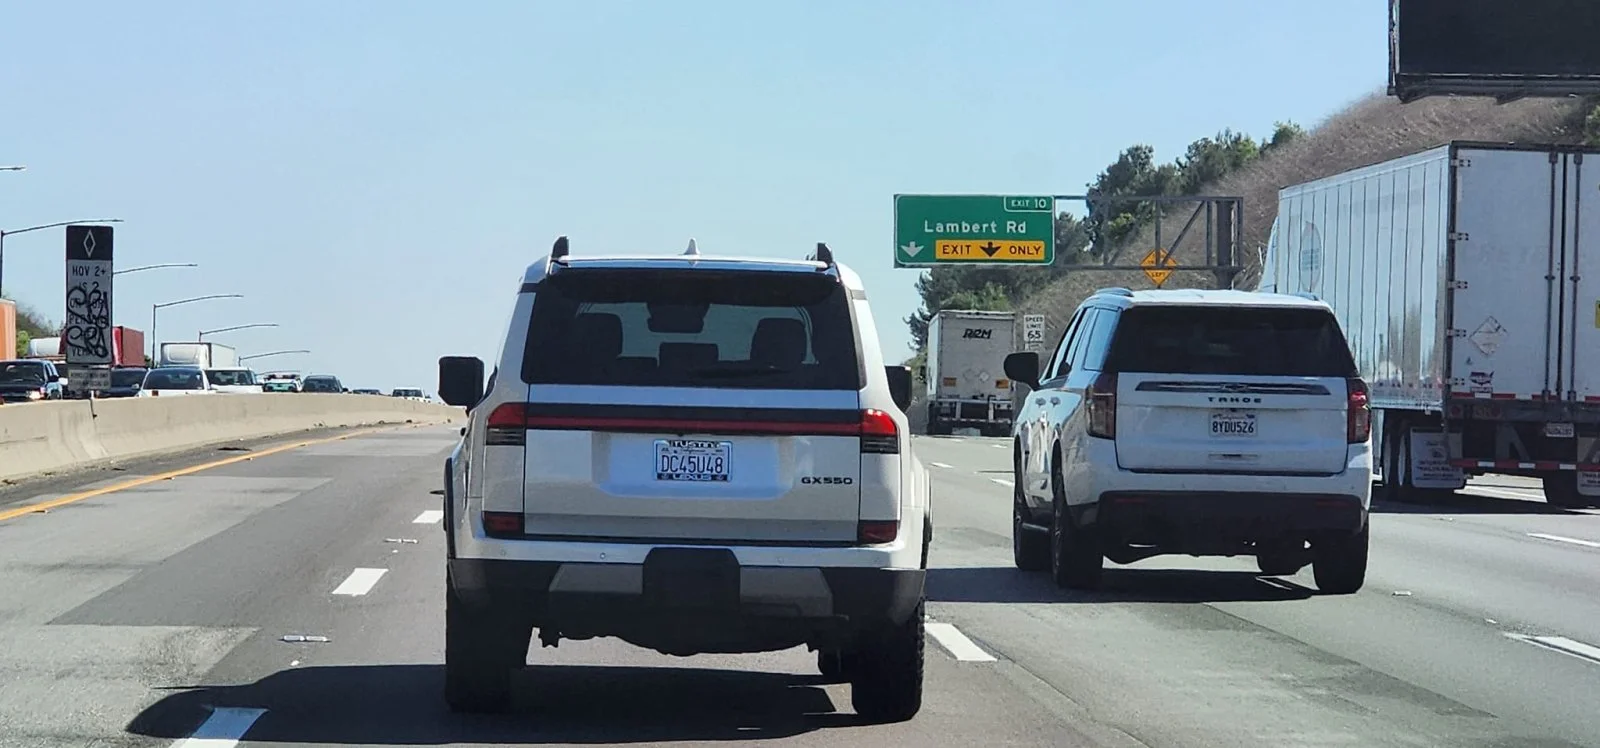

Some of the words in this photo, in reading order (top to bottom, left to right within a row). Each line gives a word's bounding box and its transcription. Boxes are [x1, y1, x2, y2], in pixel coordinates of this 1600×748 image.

[1012, 199, 1029, 207] EXIT
[1034, 198, 1047, 208] 10
[924, 220, 997, 233] Lambert
[1006, 220, 1026, 233] Rd
[942, 244, 972, 255] EXIT
[1009, 245, 1041, 255] ONLY
[72, 265, 90, 276] HOV
[94, 265, 106, 277] 2+
[1027, 330, 1041, 339] 65
[1212, 421, 1254, 433] 8YDU526
[661, 454, 723, 474] DC45U48
[801, 476, 853, 485] GX550
